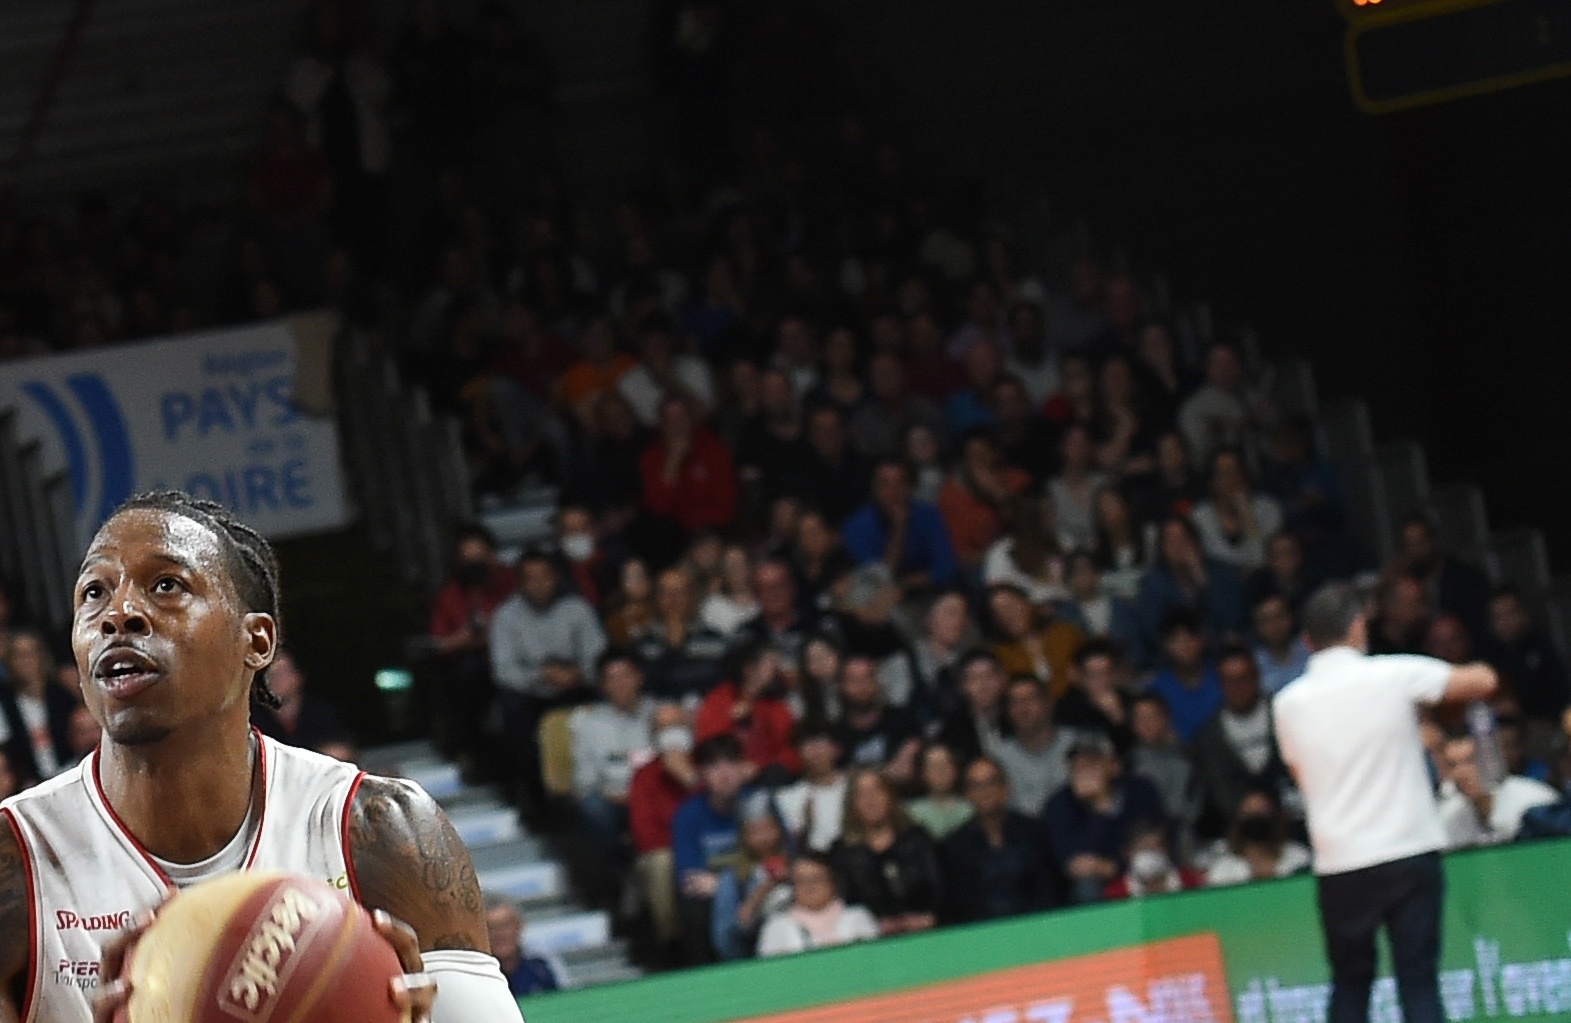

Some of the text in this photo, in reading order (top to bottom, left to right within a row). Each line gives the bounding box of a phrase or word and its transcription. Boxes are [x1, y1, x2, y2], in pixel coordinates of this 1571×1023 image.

[160, 375, 302, 440] PAYS
[152, 457, 313, 512] OIRE
[56, 910, 131, 930] SPALDING
